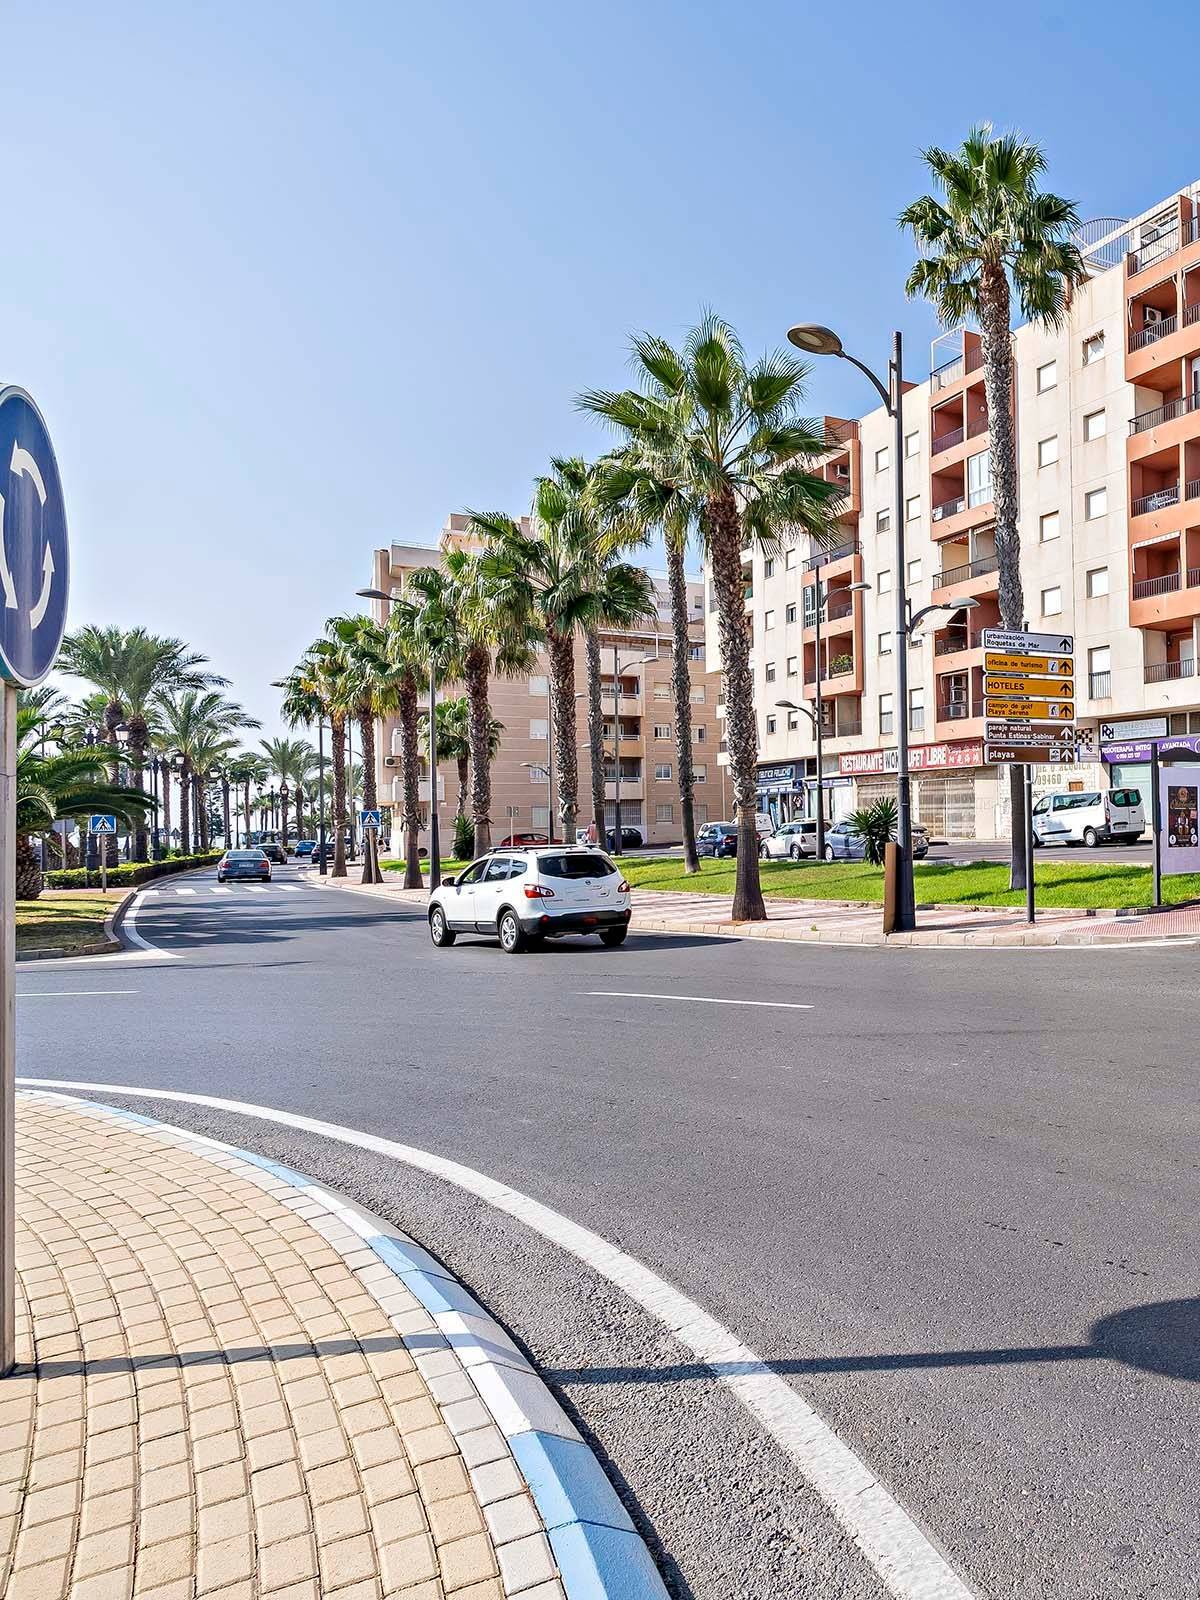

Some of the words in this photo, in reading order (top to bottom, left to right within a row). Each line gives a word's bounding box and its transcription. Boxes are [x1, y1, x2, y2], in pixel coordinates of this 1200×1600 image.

[987, 633, 1024, 641] urbanización
[987, 681, 1025, 691] HOTELES
[1161, 740, 1191, 750] AVANZADA
[842, 751, 883, 772] RESTAURANTE
[908, 748, 923, 769] UFFET
[989, 750, 1015, 760] playas
